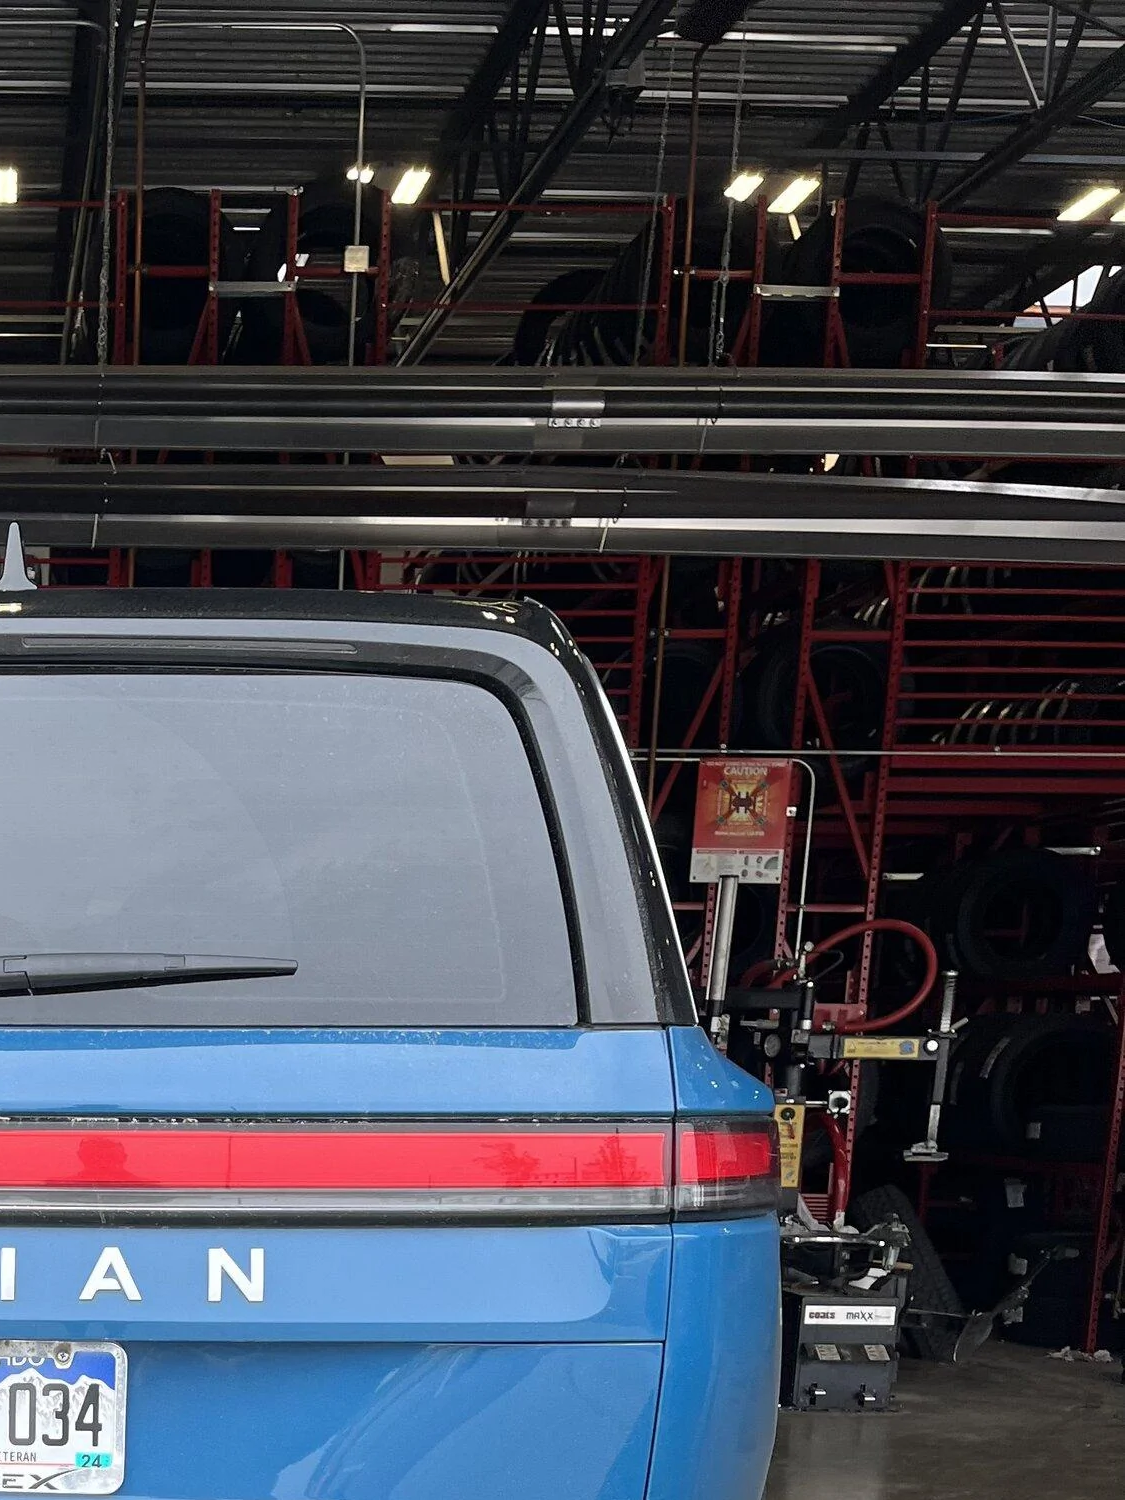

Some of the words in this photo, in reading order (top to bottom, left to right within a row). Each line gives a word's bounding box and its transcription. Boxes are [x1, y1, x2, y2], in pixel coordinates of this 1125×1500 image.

[723, 766, 768, 776] CAUTION
[8, 1382, 103, 1447] 034
[81, 1454, 103, 1468] 24
